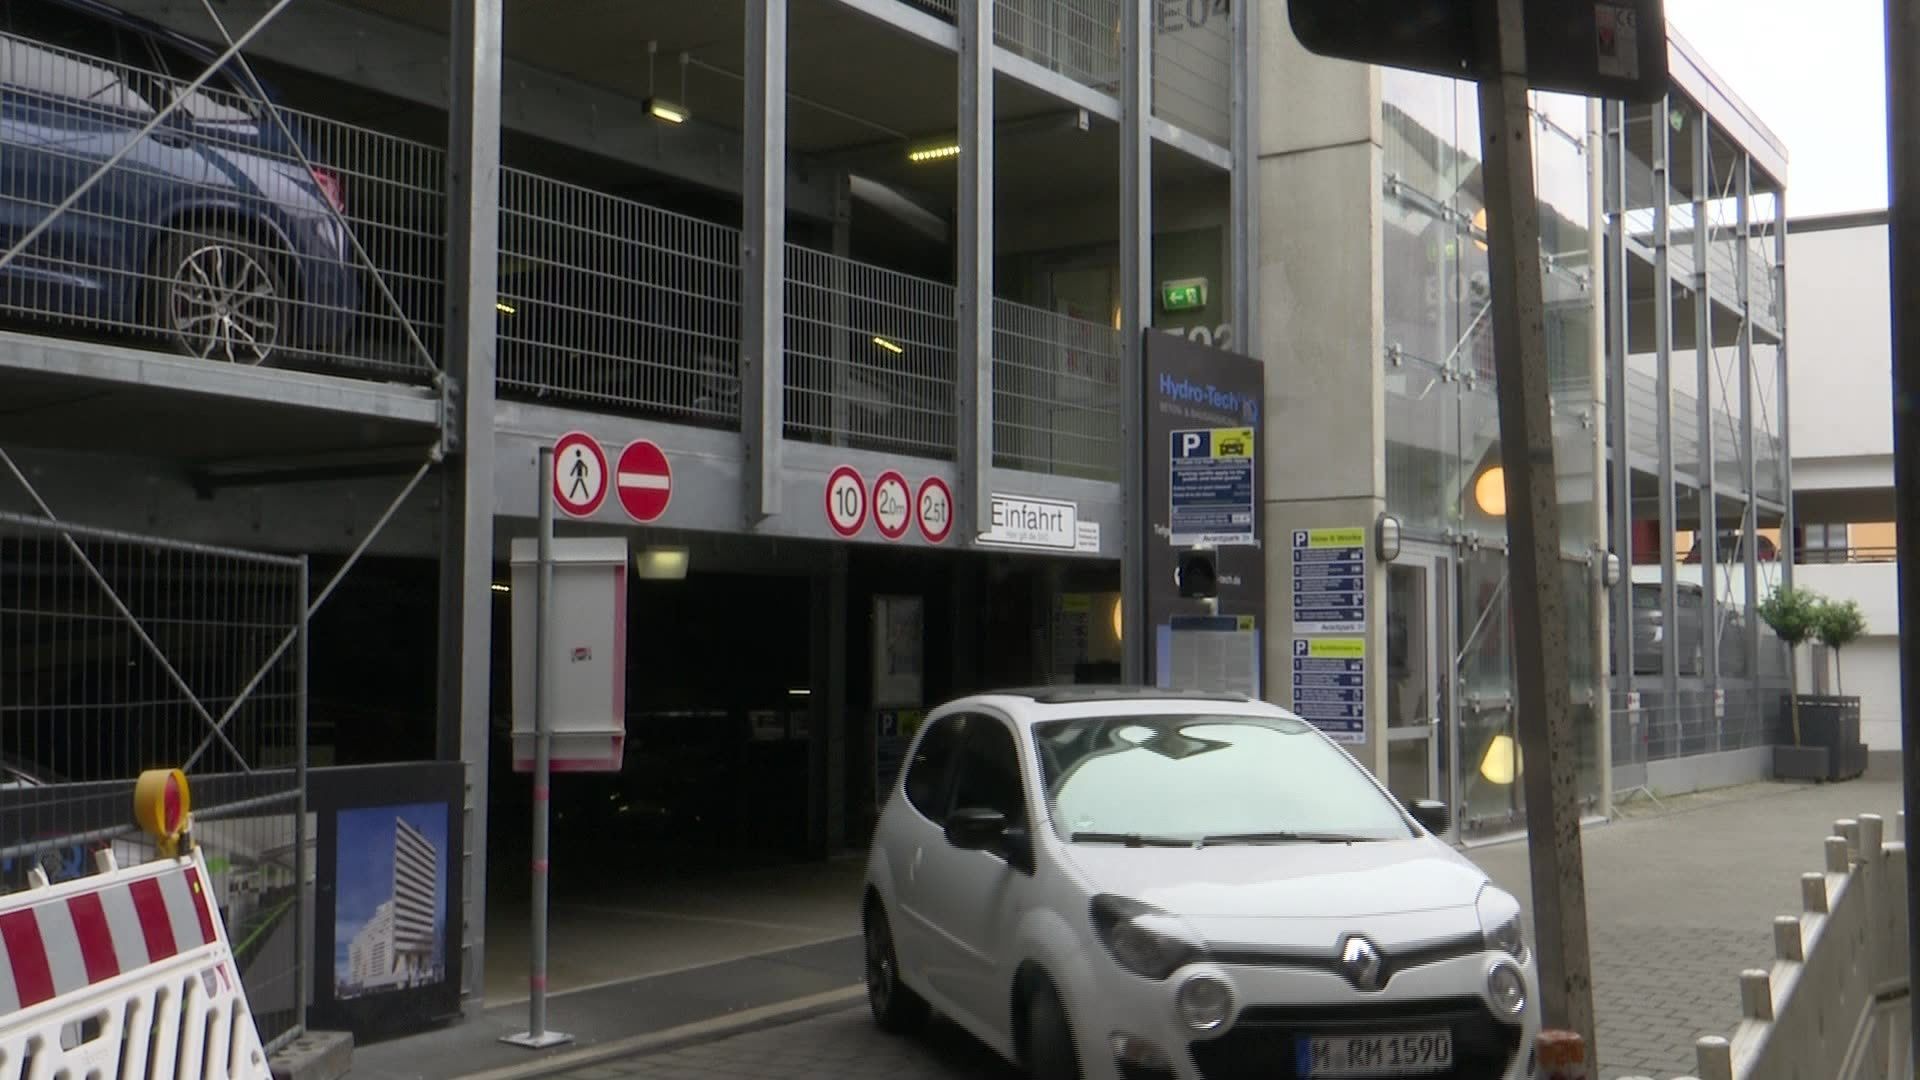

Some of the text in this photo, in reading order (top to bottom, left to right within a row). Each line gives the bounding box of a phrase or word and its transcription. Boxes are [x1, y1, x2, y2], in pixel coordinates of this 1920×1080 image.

[1183, 433, 1201, 457] P
[836, 487, 858, 517] 10
[991, 501, 1063, 533] Einfahrt
[1295, 532, 1306, 547] P
[1295, 641, 1306, 655] P
